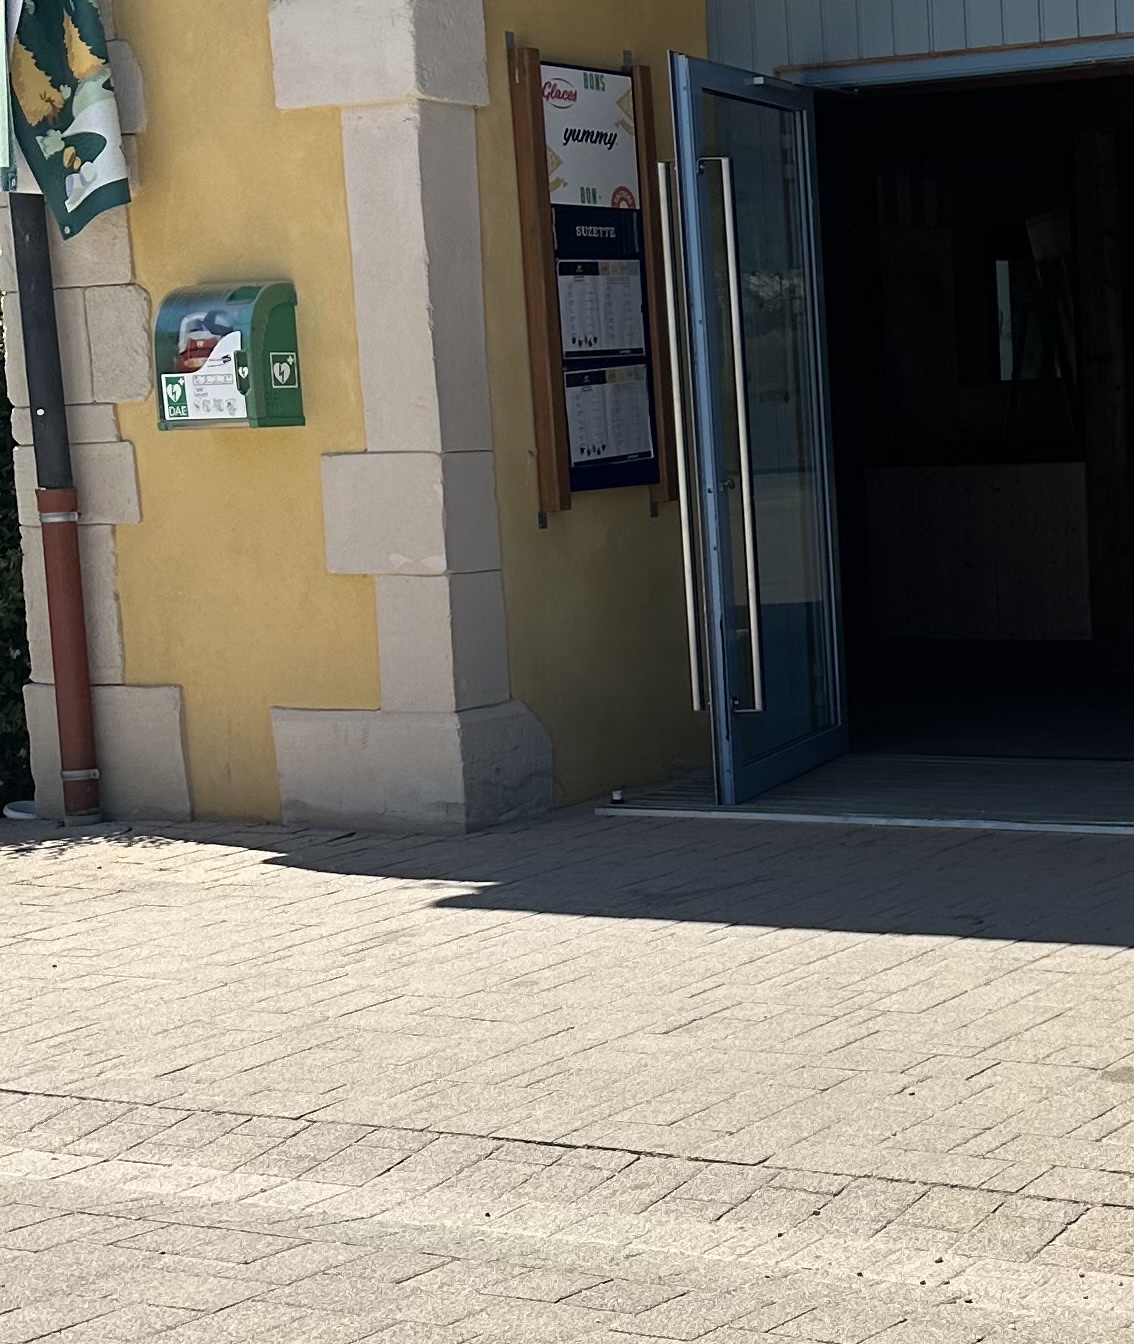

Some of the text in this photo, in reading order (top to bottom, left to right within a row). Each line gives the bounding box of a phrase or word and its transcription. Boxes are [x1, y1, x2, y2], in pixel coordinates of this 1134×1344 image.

[542, 81, 577, 102] Glaces
[562, 127, 618, 151] yummy
[575, 225, 617, 238] SUZETTE
[168, 405, 188, 417] DAE
